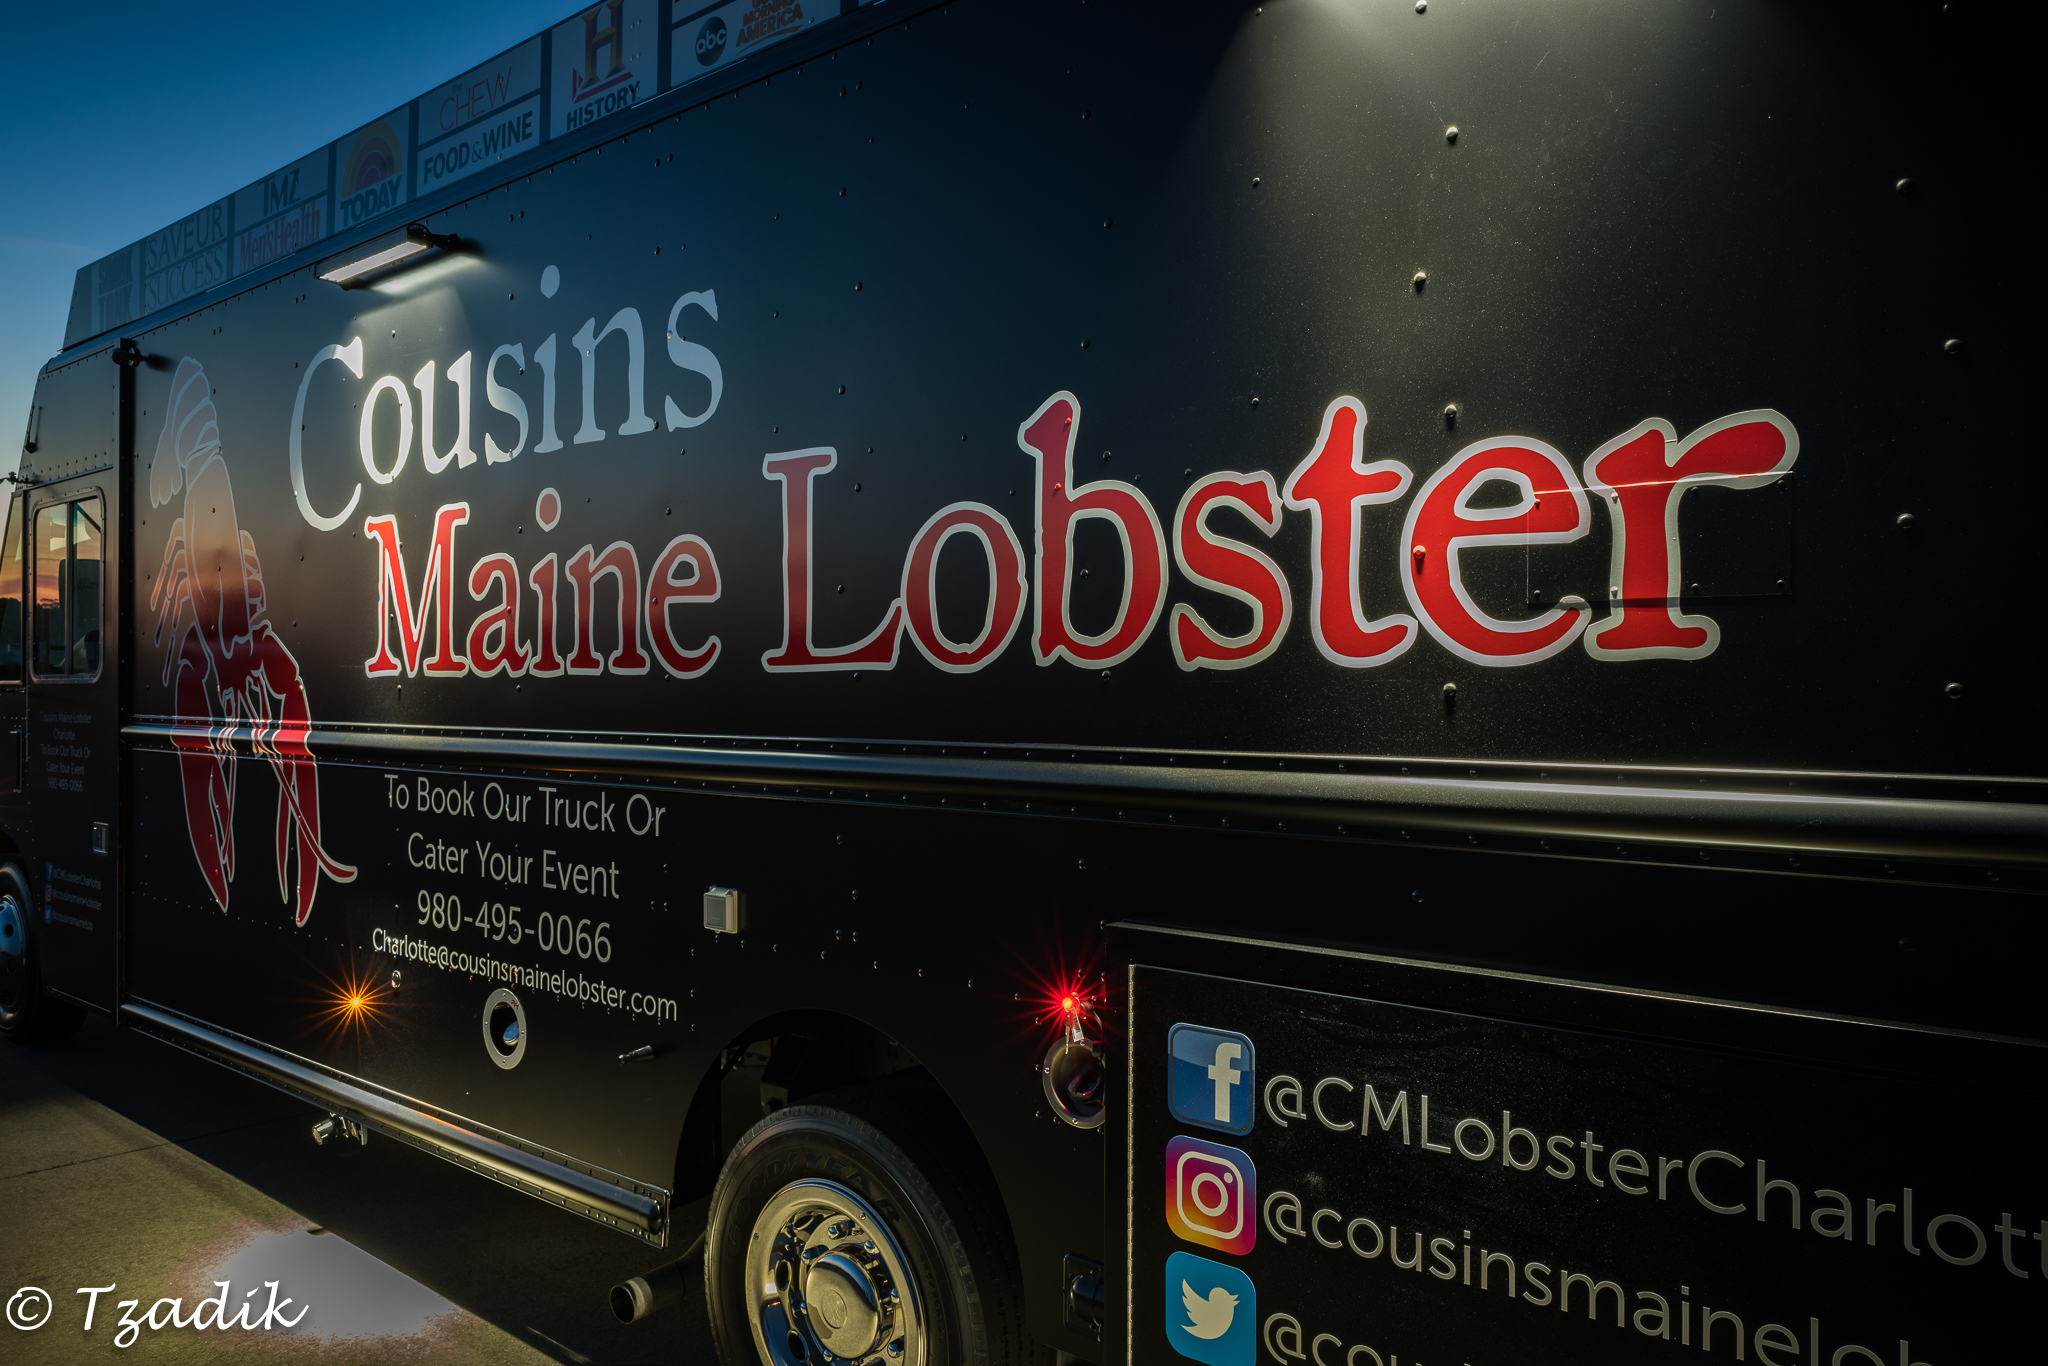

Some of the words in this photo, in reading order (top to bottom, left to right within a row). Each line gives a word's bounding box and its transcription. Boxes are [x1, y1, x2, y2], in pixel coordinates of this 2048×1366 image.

[696, 28, 727, 55] abc
[736, 3, 804, 47] AMERICA
[439, 66, 512, 131] CHEW
[451, 83, 463, 94] The
[566, 80, 640, 131] HISTORY
[257, 168, 301, 217] TMZ
[340, 175, 403, 228] TODAY
[148, 204, 224, 272] SAVEUR
[148, 245, 223, 310] SUCCESS
[289, 264, 723, 531] Cousins
[364, 487, 722, 680] Maine
[761, 389, 1800, 674] Lobster
[46, 760, 58, 773] Cater
[59, 762, 70, 774] Your
[71, 762, 85, 776] Event
[47, 744, 59, 756] Book
[60, 745, 69, 757] Our
[70, 745, 83, 758] Truck
[384, 774, 410, 810] To
[417, 776, 475, 817] Book
[483, 782, 532, 823] Our
[539, 786, 616, 832] Truck
[626, 793, 666, 837] Or
[408, 832, 469, 874] Cater
[475, 841, 533, 885] Your
[542, 849, 620, 899] Event
[417, 889, 612, 963] 980-495-0066
[372, 928, 678, 1021] Charlotte@cousinsmainelobster.com
[725, 1151, 903, 1258] GOODYEAR
